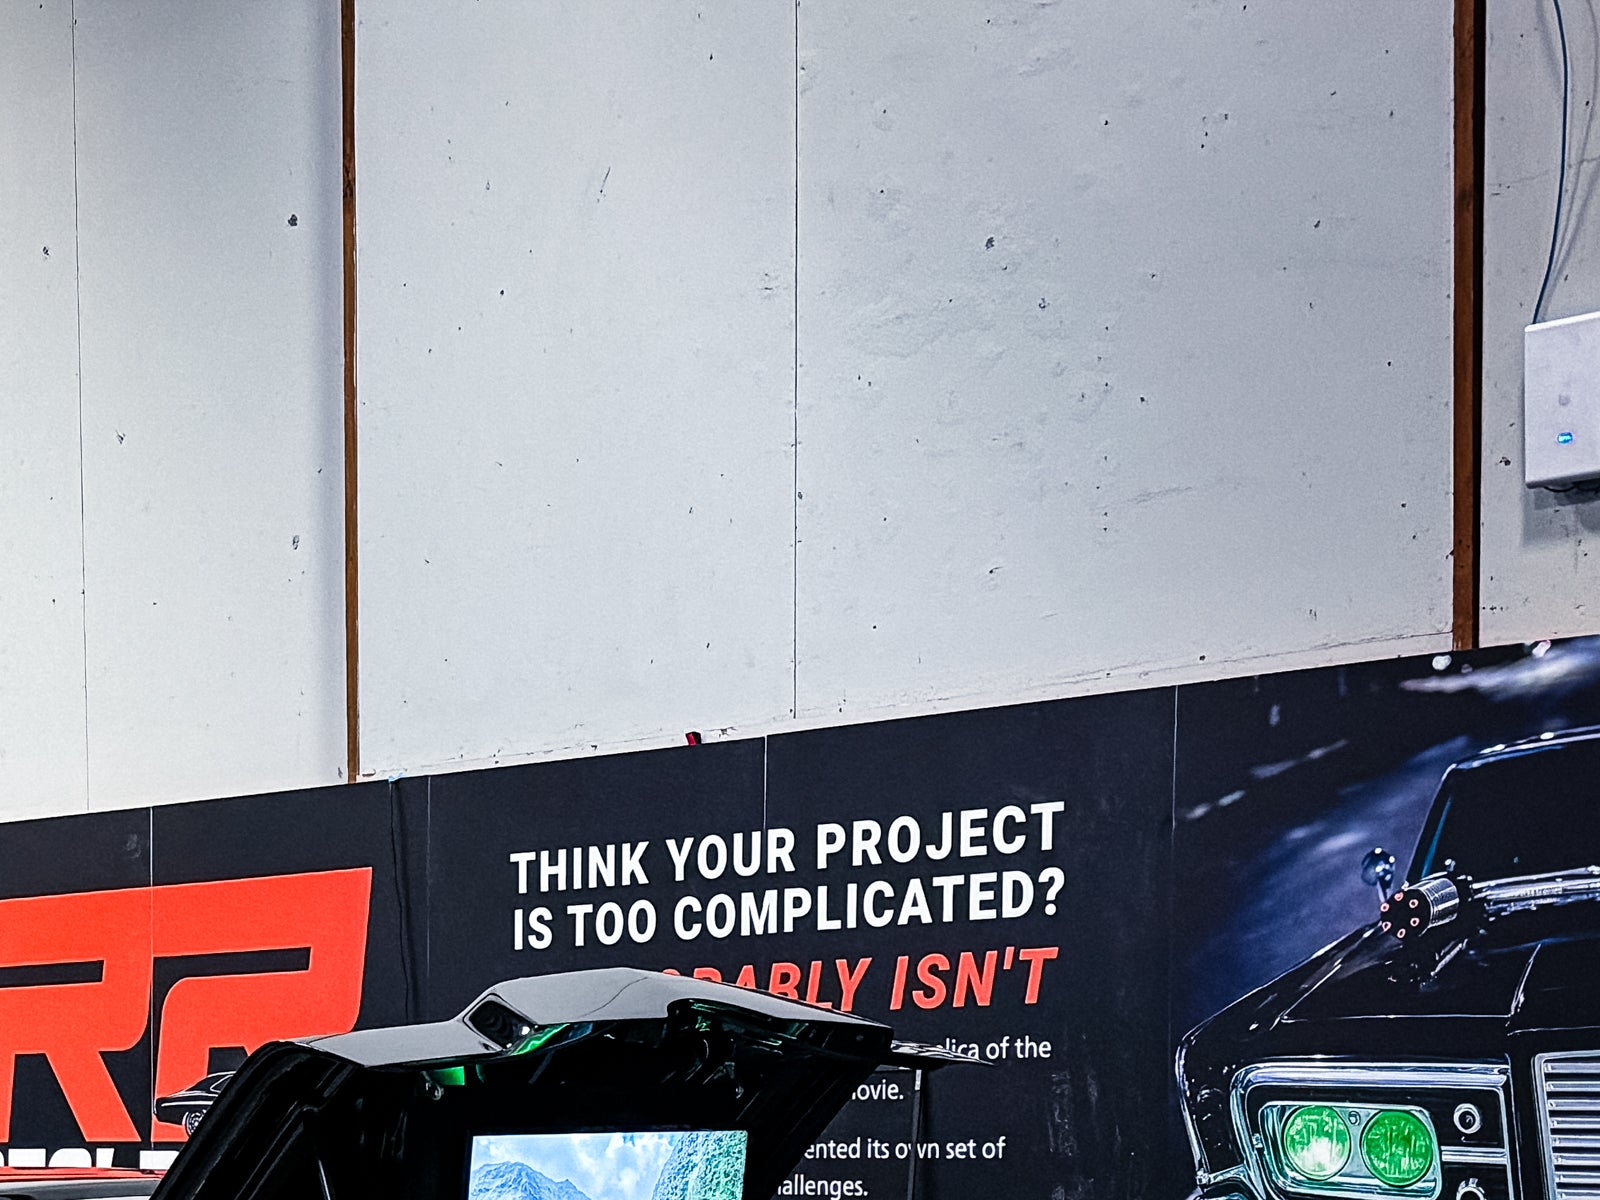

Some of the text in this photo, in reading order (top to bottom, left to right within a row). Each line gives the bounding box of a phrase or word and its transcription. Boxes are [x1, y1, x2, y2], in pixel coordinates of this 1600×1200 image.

[509, 801, 1065, 894] THINK YOUR PROJECT
[514, 866, 1065, 950] IS TOO COMPLICATED?
[889, 946, 1059, 1011] ISN'T
[986, 1036, 1010, 1060] of
[1014, 1035, 1052, 1059] the
[852, 1078, 905, 1101] ovie.
[804, 1136, 861, 1160] ented
[867, 1138, 890, 1160] its
[945, 1138, 977, 1160] set
[981, 1135, 1007, 1160] of
